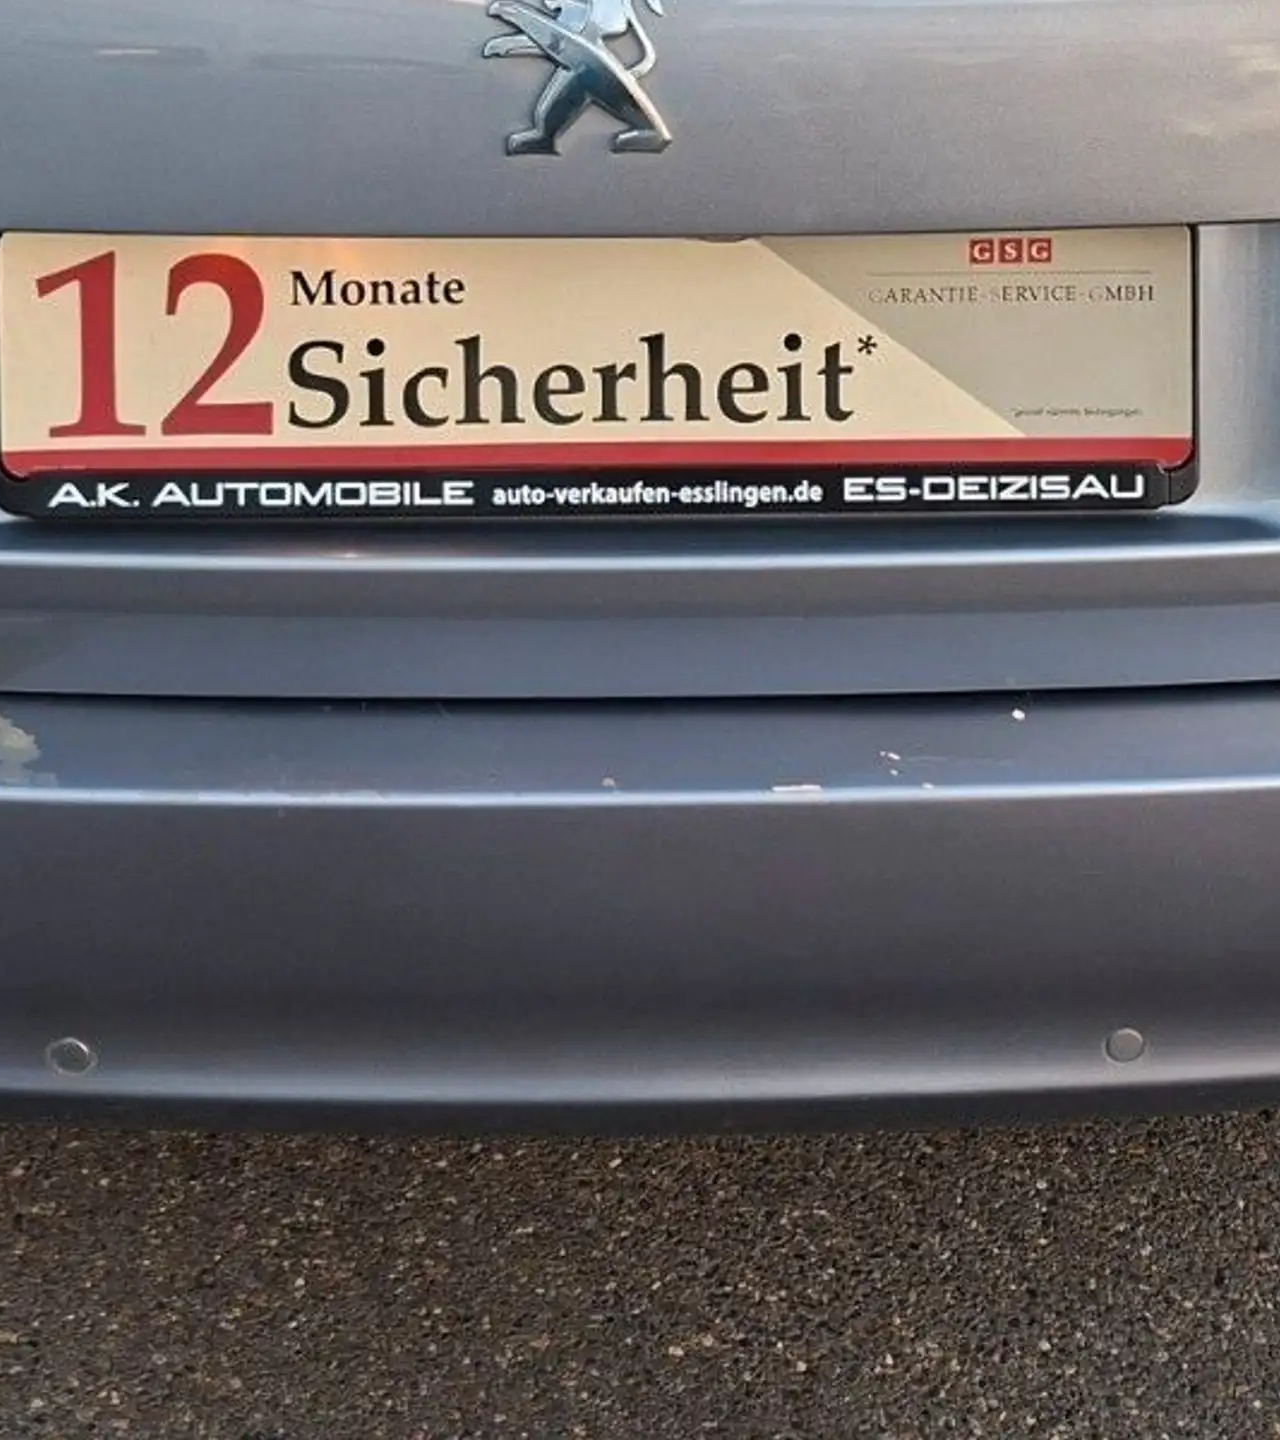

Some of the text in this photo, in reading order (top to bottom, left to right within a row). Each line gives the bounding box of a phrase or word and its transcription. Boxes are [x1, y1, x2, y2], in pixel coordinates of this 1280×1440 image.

[969, 238, 1052, 264] GSG
[290, 269, 466, 306] Monate
[35, 250, 274, 438] 12
[47, 476, 1144, 508] A.K. AUTOMOBILE auto-verkaufen-esslingen.de ES-DEIZISAU
